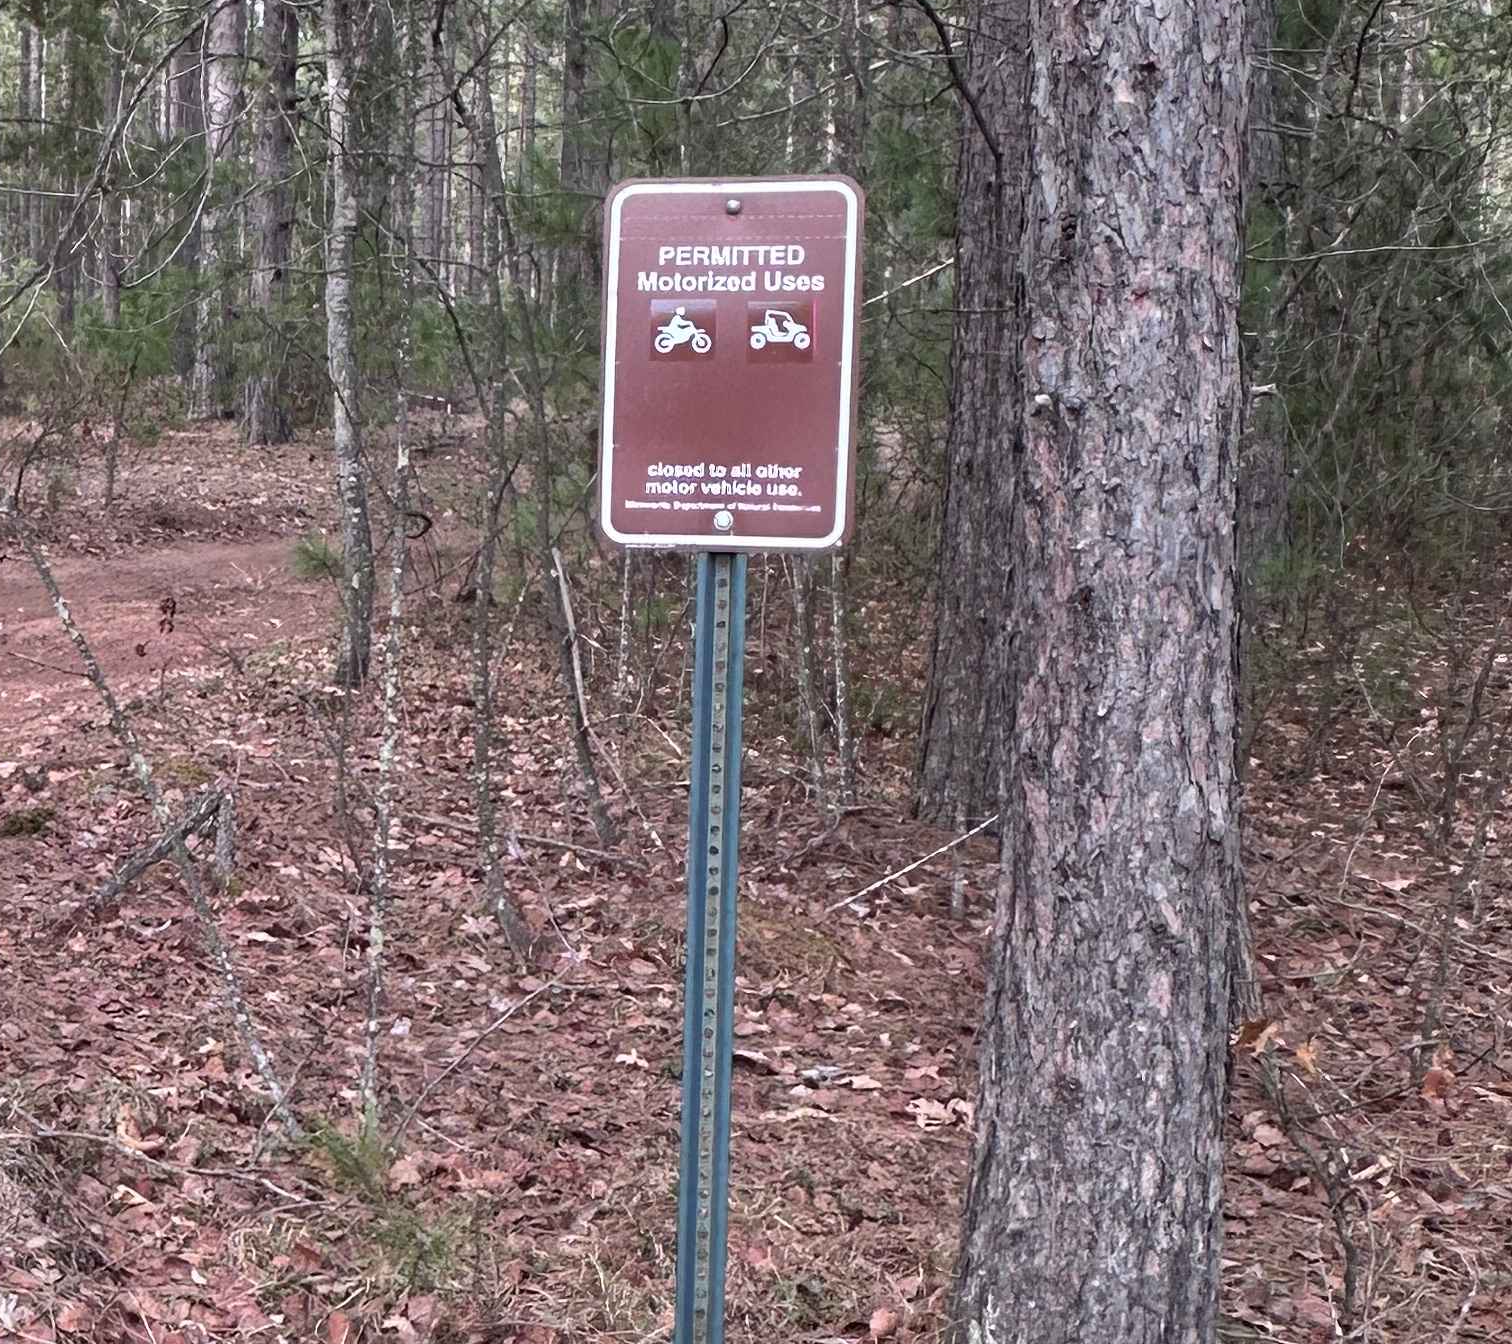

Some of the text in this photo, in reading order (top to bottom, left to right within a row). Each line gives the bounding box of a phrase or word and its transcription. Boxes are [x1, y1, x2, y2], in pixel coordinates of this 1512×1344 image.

[659, 245, 806, 266] PERMITTED
[637, 270, 825, 292] Motorized Uses
[647, 461, 803, 479] closed to all other
[645, 479, 803, 497] motor vehicle use.
